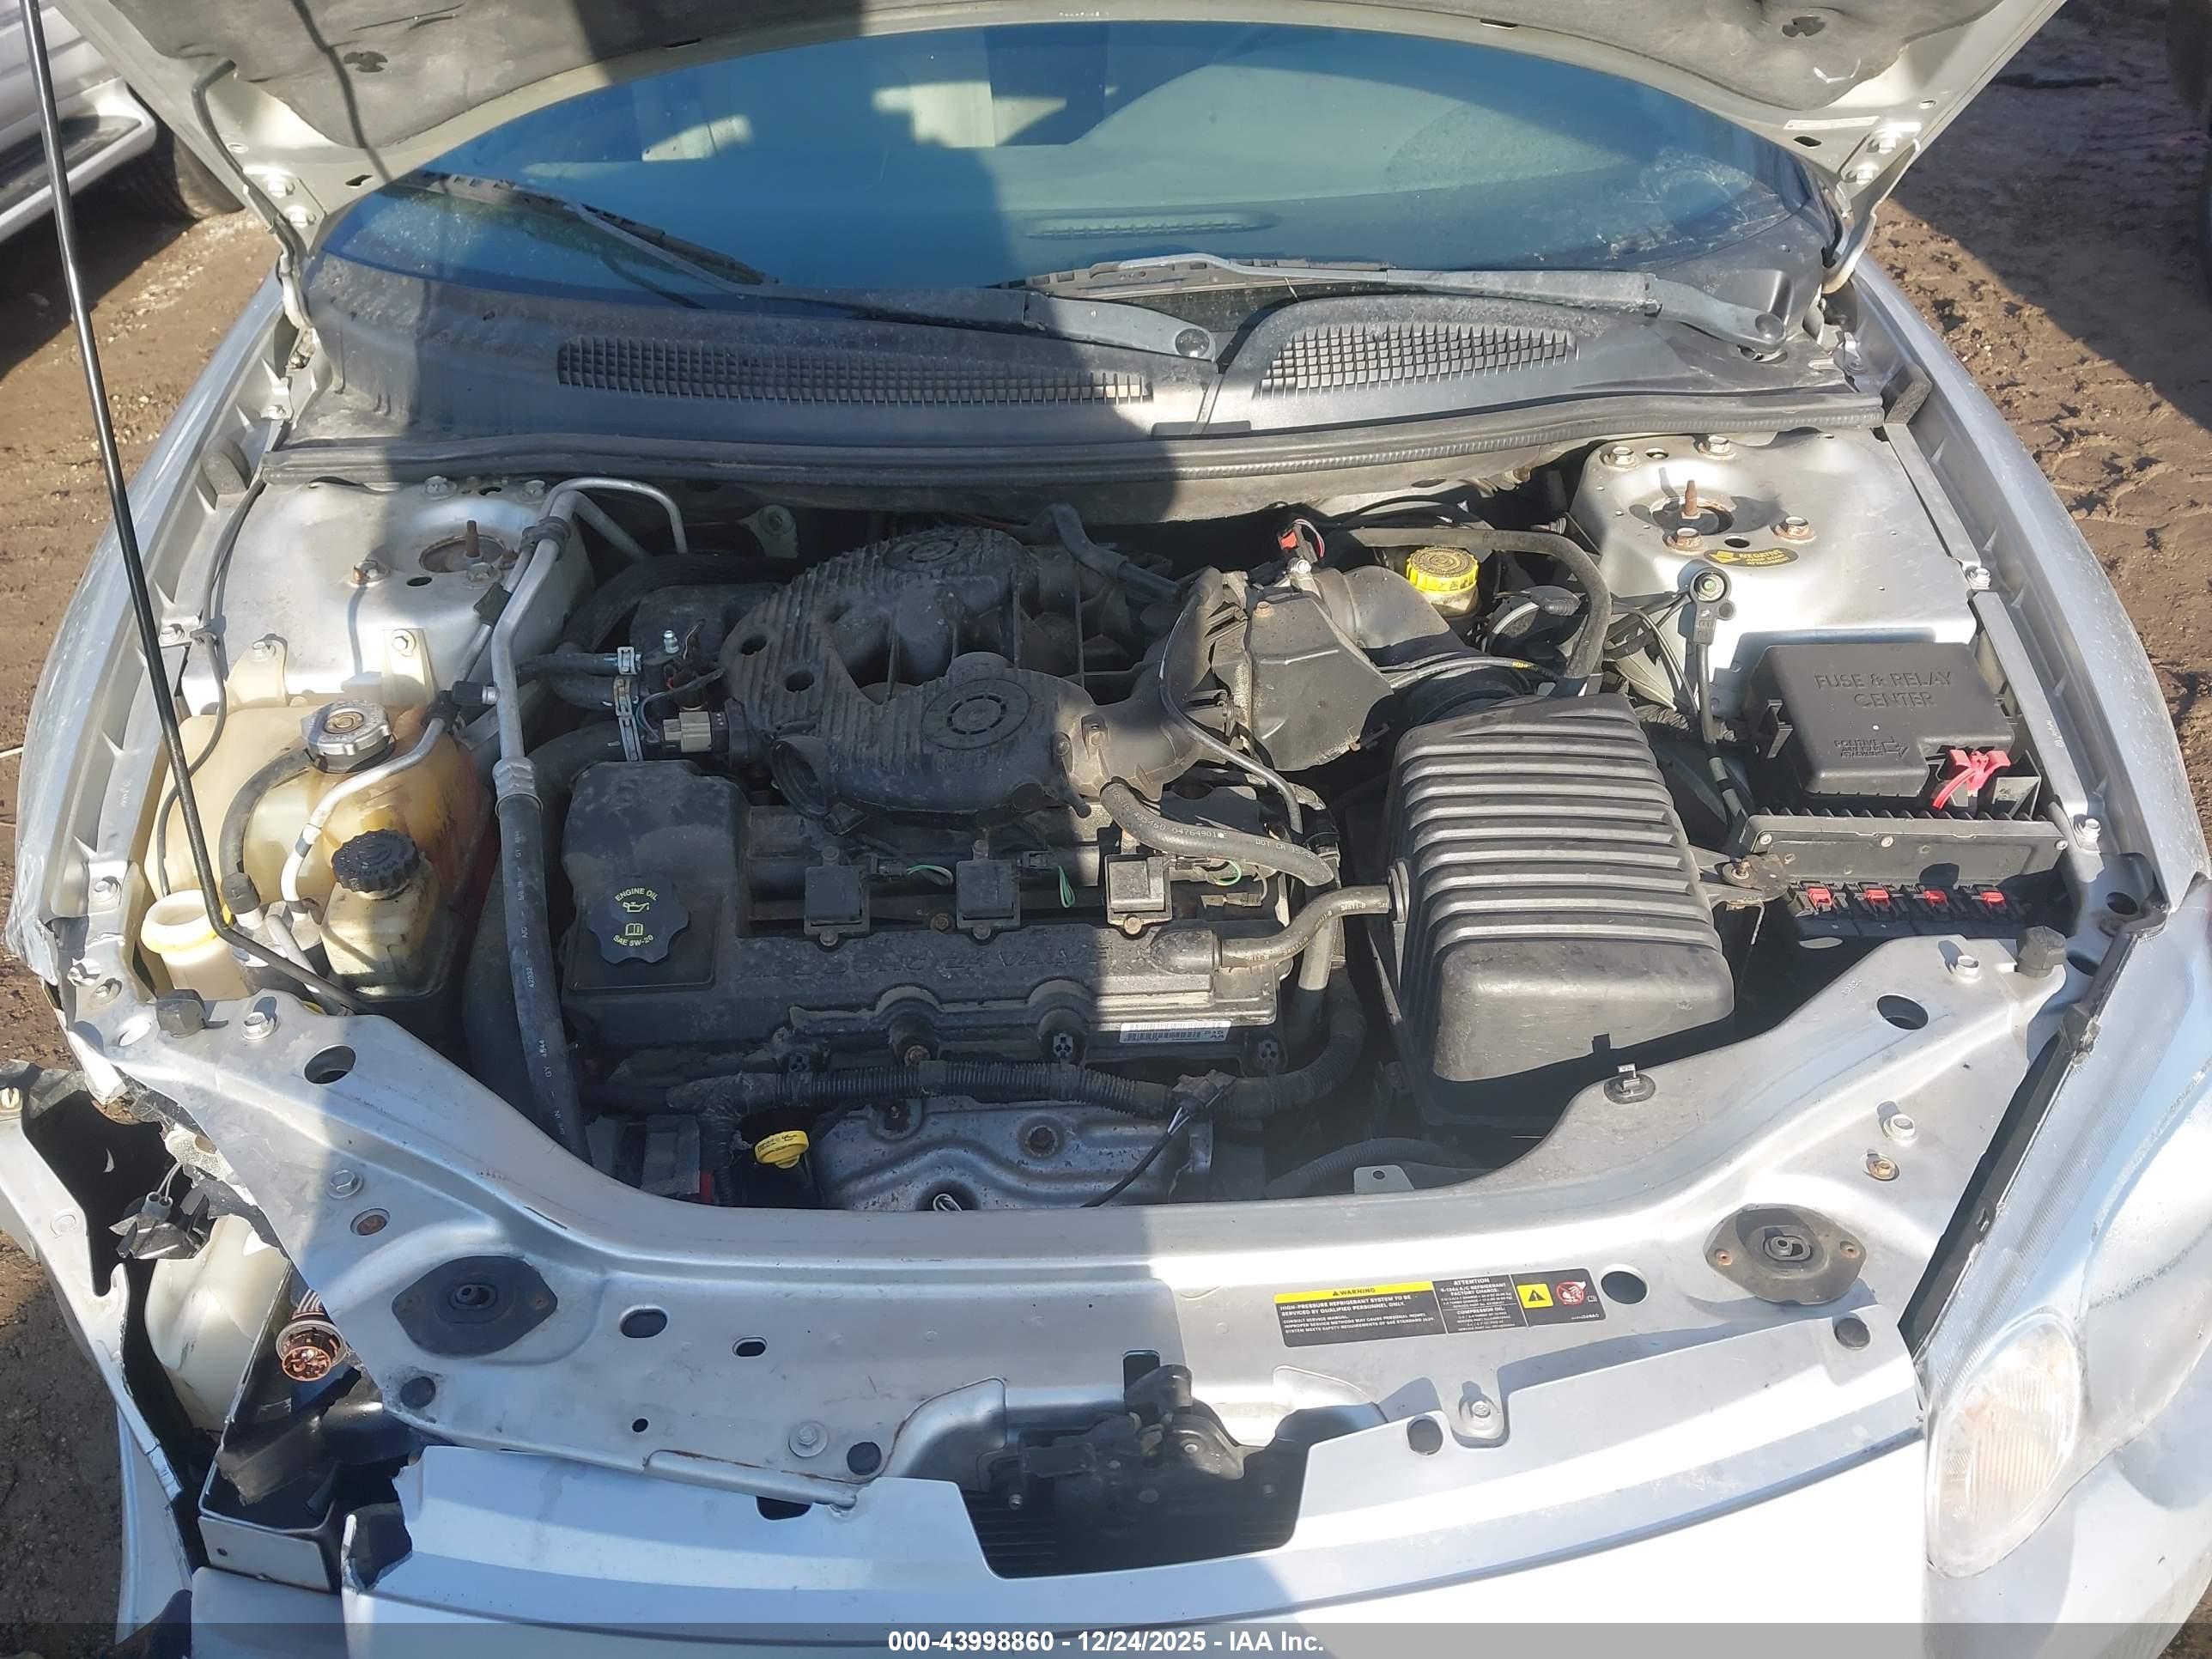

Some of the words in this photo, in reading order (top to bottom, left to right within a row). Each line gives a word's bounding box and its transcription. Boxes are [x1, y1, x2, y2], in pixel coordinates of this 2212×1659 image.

[1814, 673, 1865, 689] FUSE
[1870, 672, 1884, 687] &
[1890, 671, 1952, 687] RELAY
[1853, 691, 1935, 708] CENTER
[615, 887, 646, 902] ENGINE
[646, 890, 659, 902] OIL
[613, 934, 629, 946] SAE
[629, 934, 654, 947] 5W-20
[1454, 1277, 1490, 1286] ATTENTION
[1340, 1287, 1376, 1296] WARNING
[1279, 1302, 1328, 1310] HIGH-PRESSURE
[1328, 1298, 1370, 1307] REFRIGERANT
